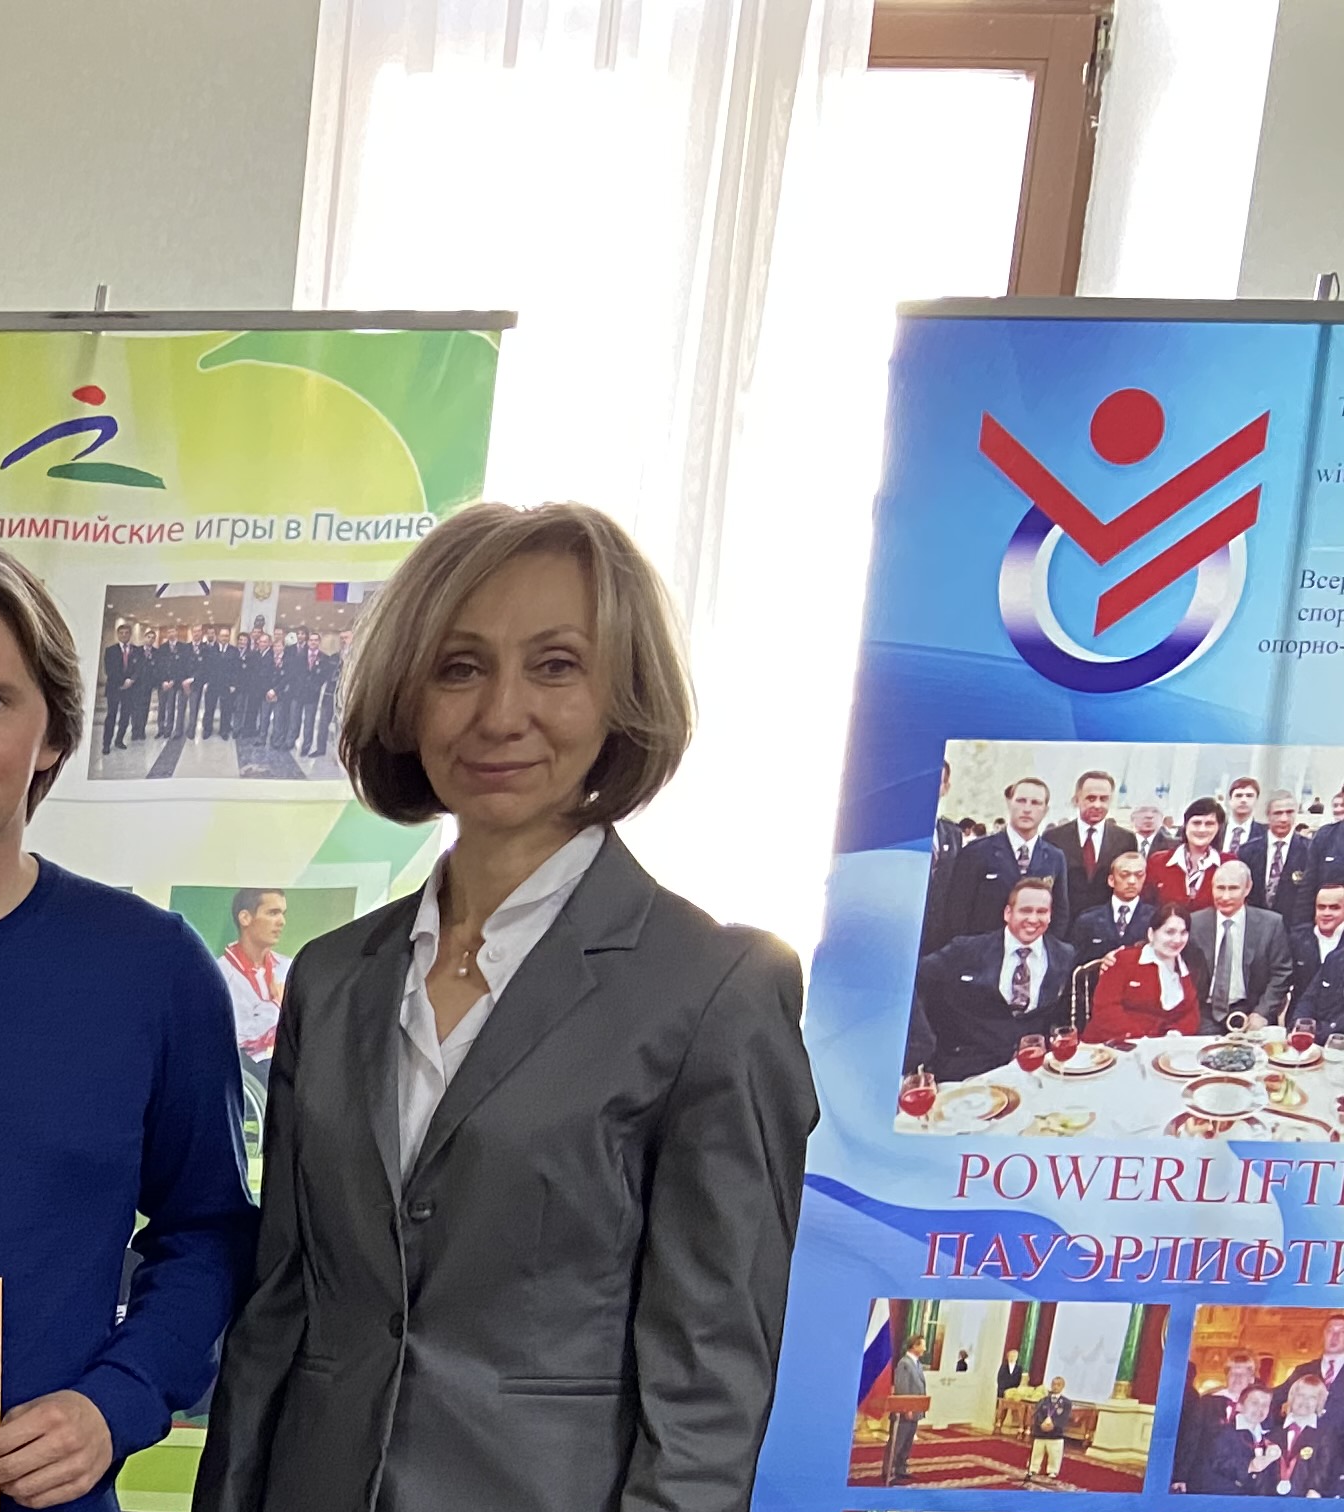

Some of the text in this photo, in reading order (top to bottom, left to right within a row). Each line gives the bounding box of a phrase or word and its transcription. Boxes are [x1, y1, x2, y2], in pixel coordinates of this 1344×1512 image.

[195, 516, 275, 546] игры
[285, 517, 302, 540] в
[312, 513, 433, 541] Пекине
